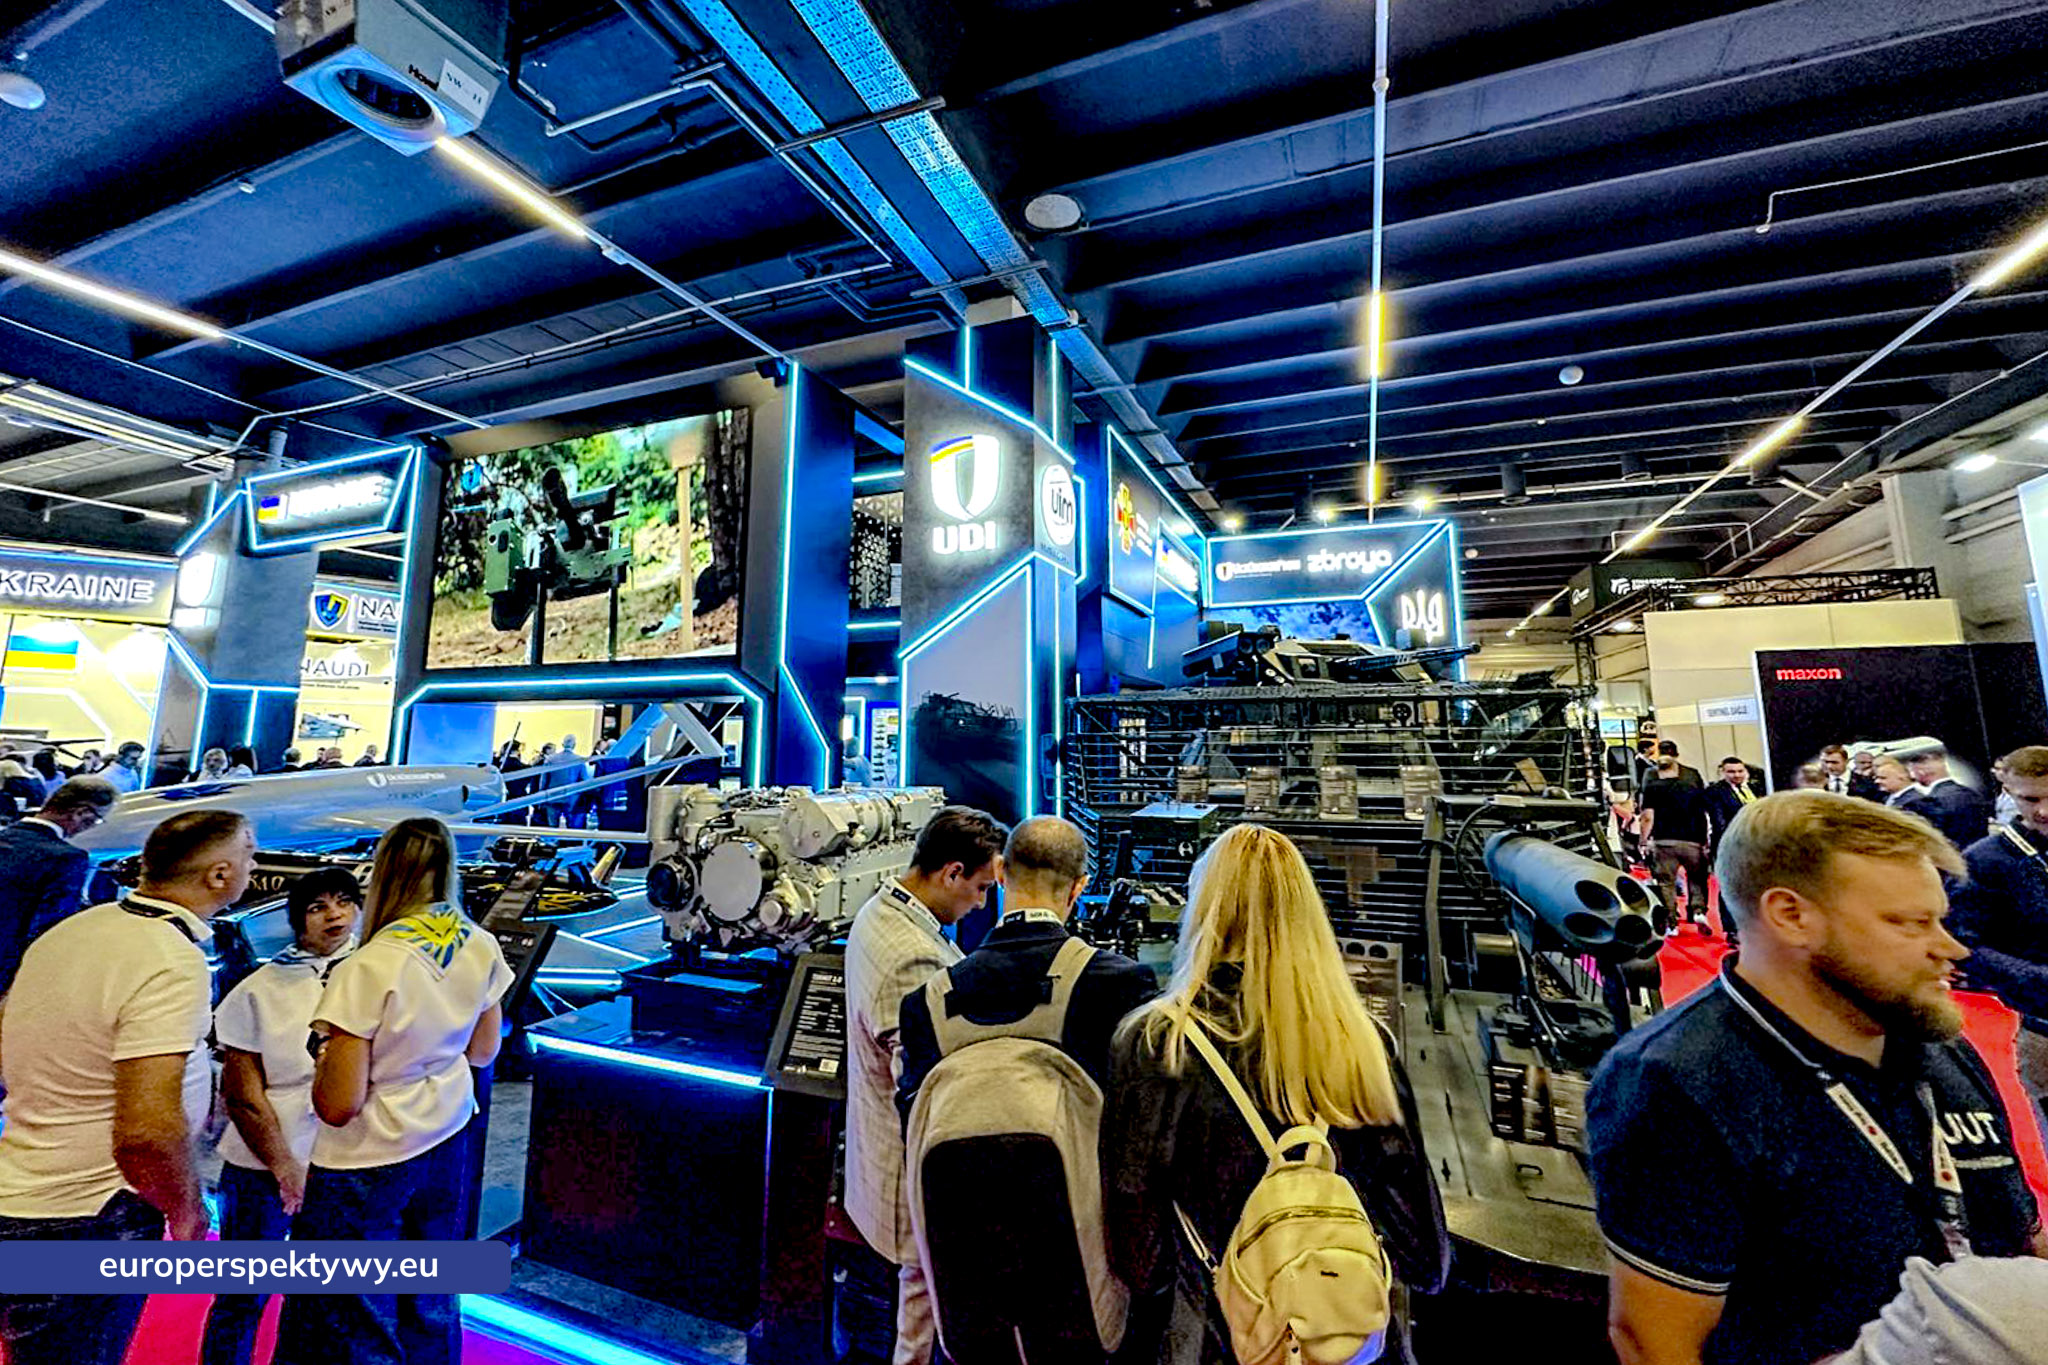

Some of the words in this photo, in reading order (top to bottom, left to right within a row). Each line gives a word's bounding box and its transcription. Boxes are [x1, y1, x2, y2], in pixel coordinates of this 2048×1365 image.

[933, 521, 997, 555] UDI
[1307, 548, 1392, 574] zbroya
[1776, 667, 1843, 680] maxon
